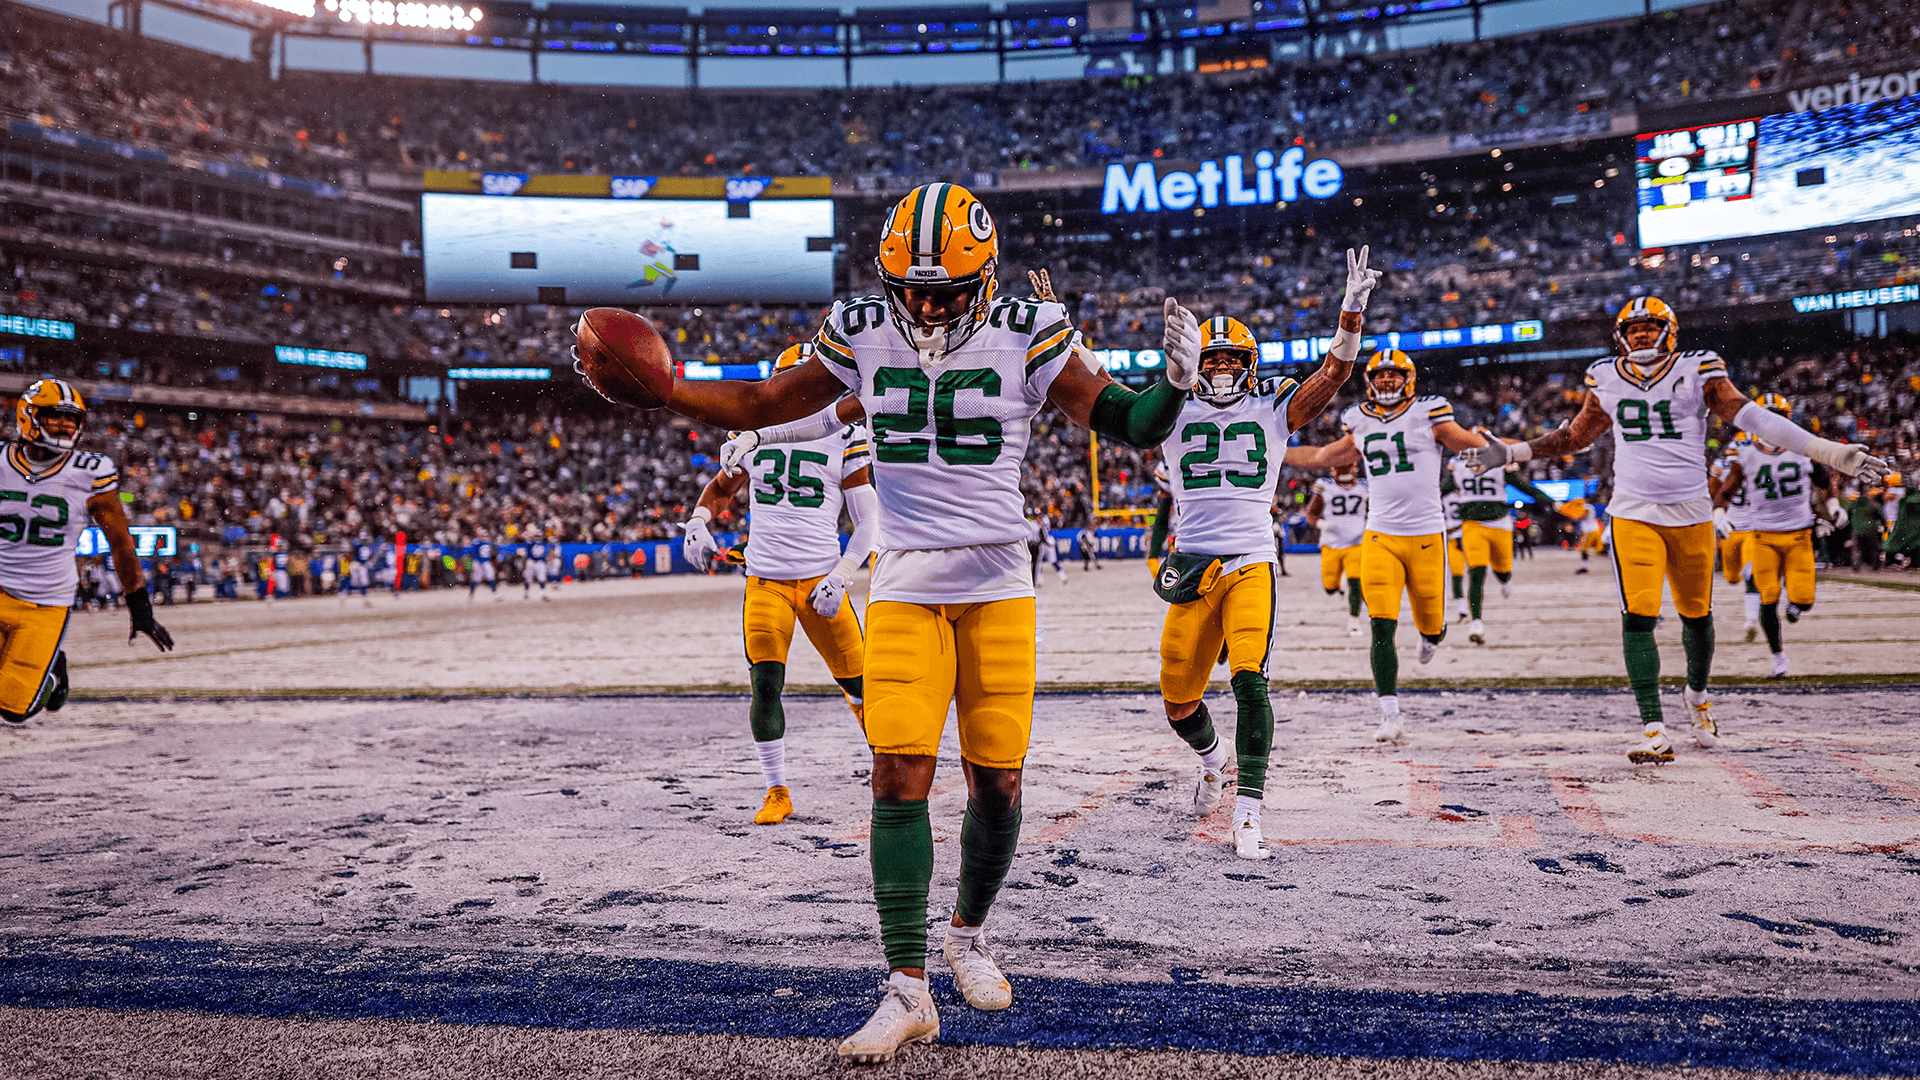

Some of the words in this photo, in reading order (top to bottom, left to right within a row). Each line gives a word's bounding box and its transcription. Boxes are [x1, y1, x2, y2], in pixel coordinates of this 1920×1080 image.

[1101, 147, 1343, 214] MetLife
[1794, 295, 1833, 312] VAN
[1836, 285, 1919, 309] HEUSEN
[0, 315, 75, 340] HEUSEN
[872, 366, 1003, 465] 26
[1617, 399, 1682, 441] 91
[1180, 421, 1267, 490] 23
[1363, 432, 1414, 476] 51
[753, 449, 829, 508] 35
[1755, 462, 1803, 499] 42
[0, 490, 69, 546] 52
[1331, 495, 1362, 515] 97
